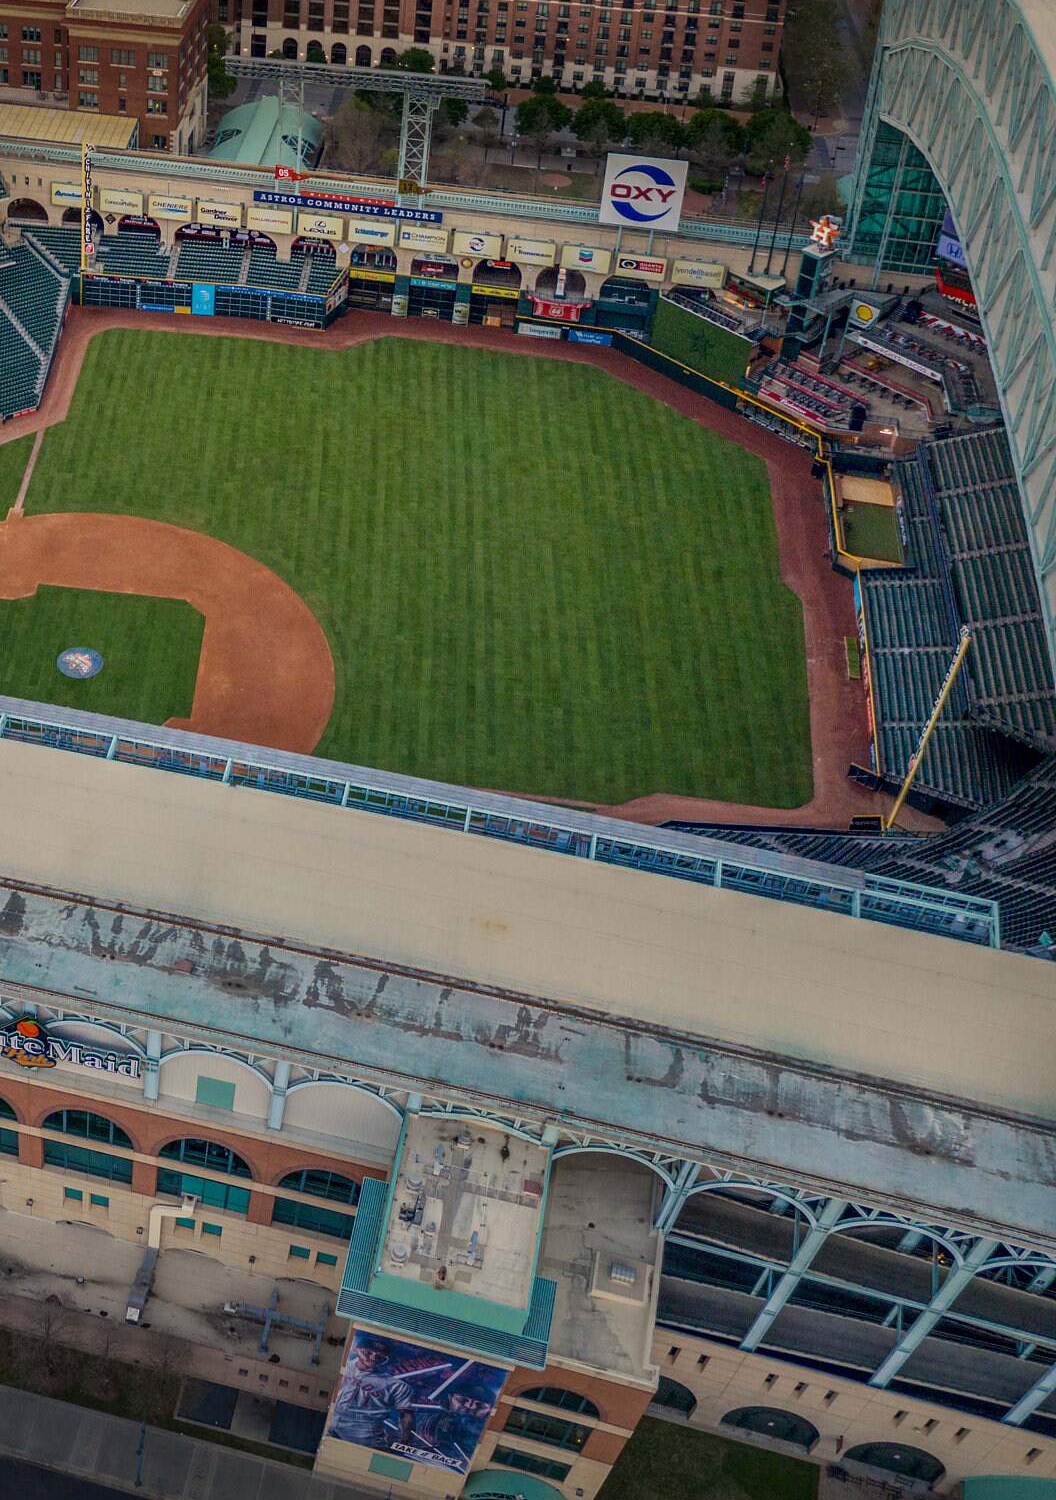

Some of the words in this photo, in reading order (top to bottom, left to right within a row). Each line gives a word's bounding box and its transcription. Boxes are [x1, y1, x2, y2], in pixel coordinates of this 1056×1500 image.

[278, 168, 289, 177] 05
[610, 184, 676, 203] OXY
[152, 201, 188, 210] CHENIERE
[307, 199, 380, 214] COMMUNITY
[384, 208, 436, 221] LEADERS
[200, 207, 228, 216] Gardner
[214, 214, 238, 223] Denver
[303, 227, 337, 236] LEXUS
[354, 227, 389, 238] Schlumberger
[410, 232, 446, 242] CHAMPION
[469, 240, 486, 248] OXY
[518, 250, 553, 259] Transocean
[640, 262, 662, 270] QUANTA
[46, 1036, 142, 1080] Maid
[394, 1443, 418, 1454] TAKE
[431, 1455, 459, 1466] BACK
